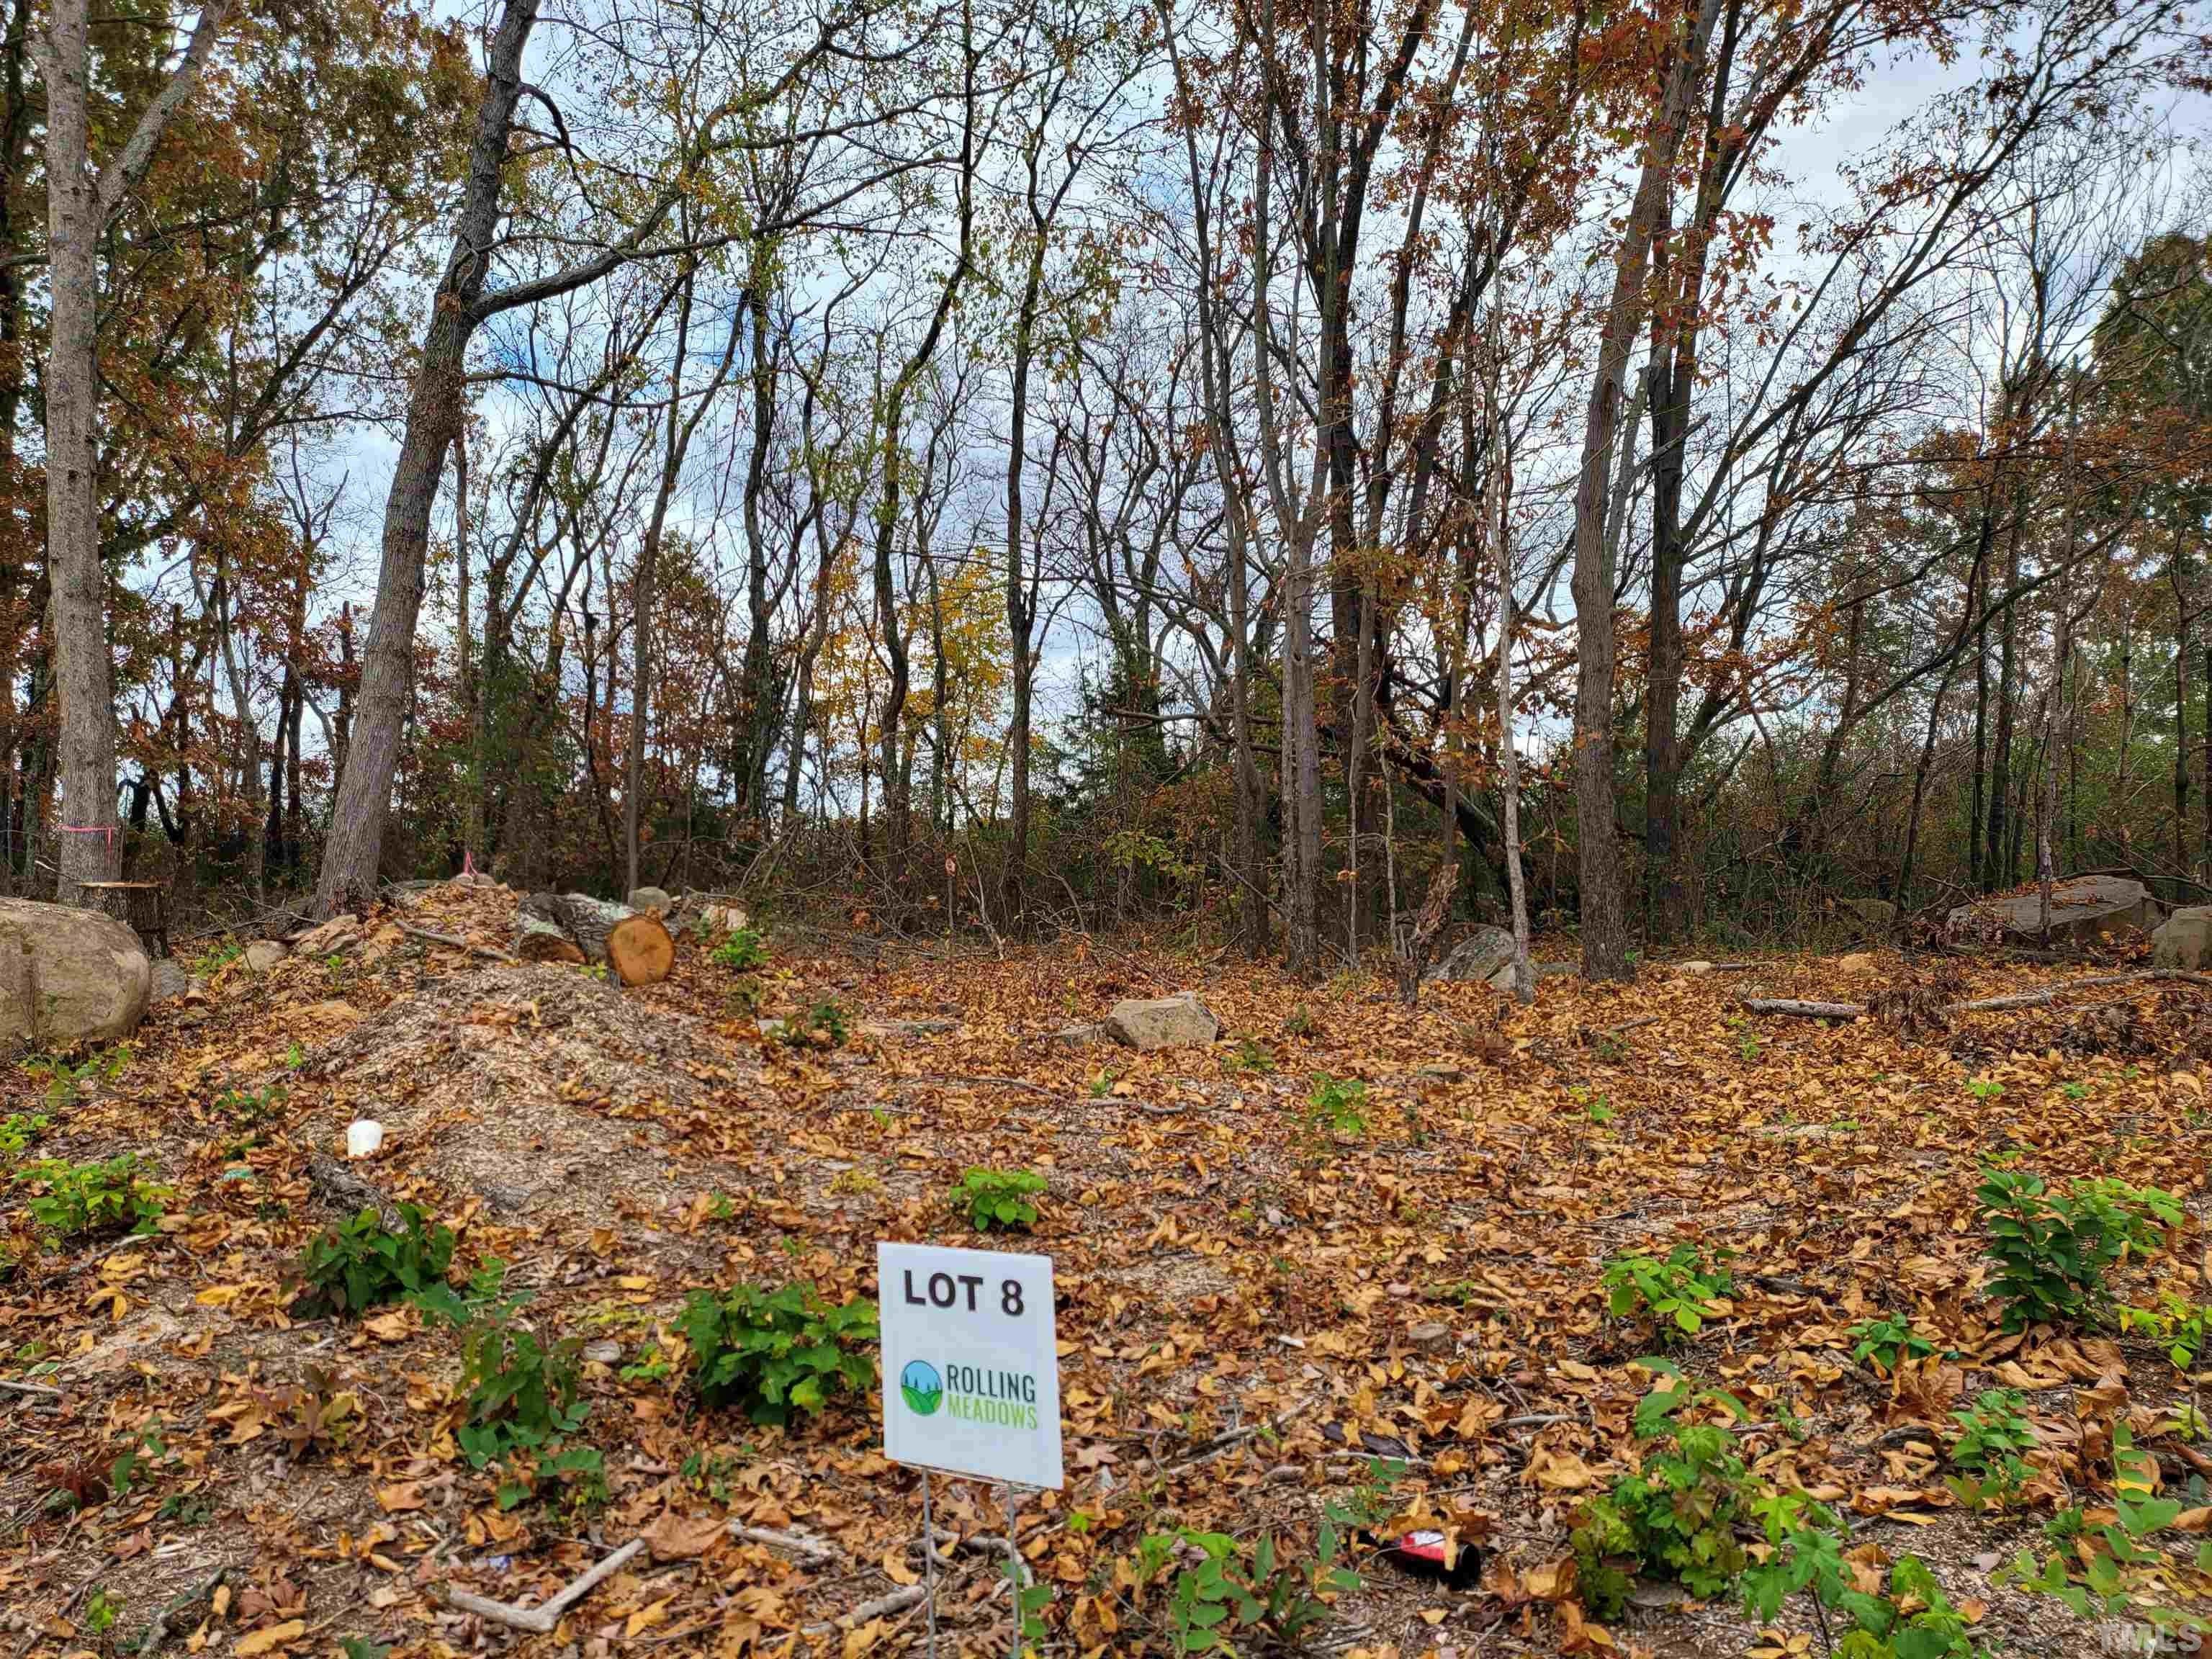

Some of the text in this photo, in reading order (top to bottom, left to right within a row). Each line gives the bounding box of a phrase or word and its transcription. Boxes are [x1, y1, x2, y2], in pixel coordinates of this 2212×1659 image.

[904, 1269, 1025, 1317] LOT 8
[947, 1364, 1035, 1403] ROLLING
[947, 1394, 1038, 1430] MEADOWS
